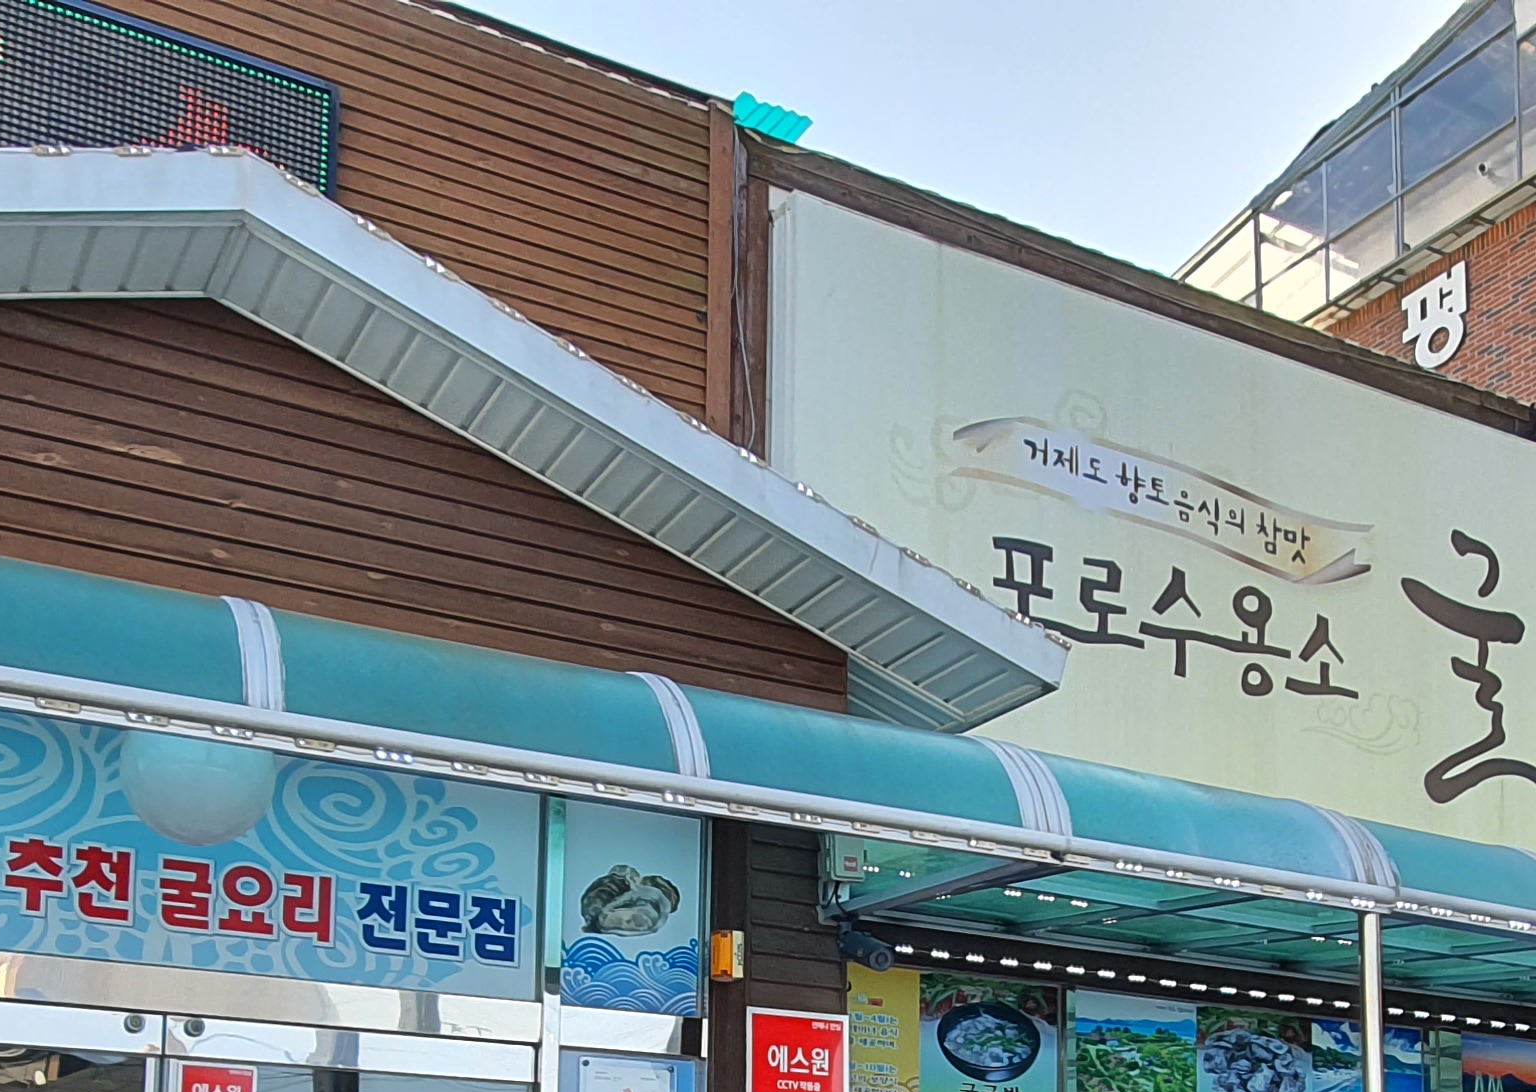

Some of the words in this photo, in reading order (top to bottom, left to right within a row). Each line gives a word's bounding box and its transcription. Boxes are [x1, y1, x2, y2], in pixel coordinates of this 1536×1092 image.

[1401, 259, 1467, 369] 평
[1024, 438, 1108, 484] 거제도
[1115, 462, 1246, 536] 향토음식의
[1257, 508, 1311, 564] 참맛
[992, 536, 1360, 699] 포로수용소
[5, 837, 135, 923] 추천
[159, 855, 334, 944] 굴요리
[357, 882, 517, 963] 전문점
[768, 1045, 829, 1076] 에스원
[777, 1080, 798, 1090] CCTV
